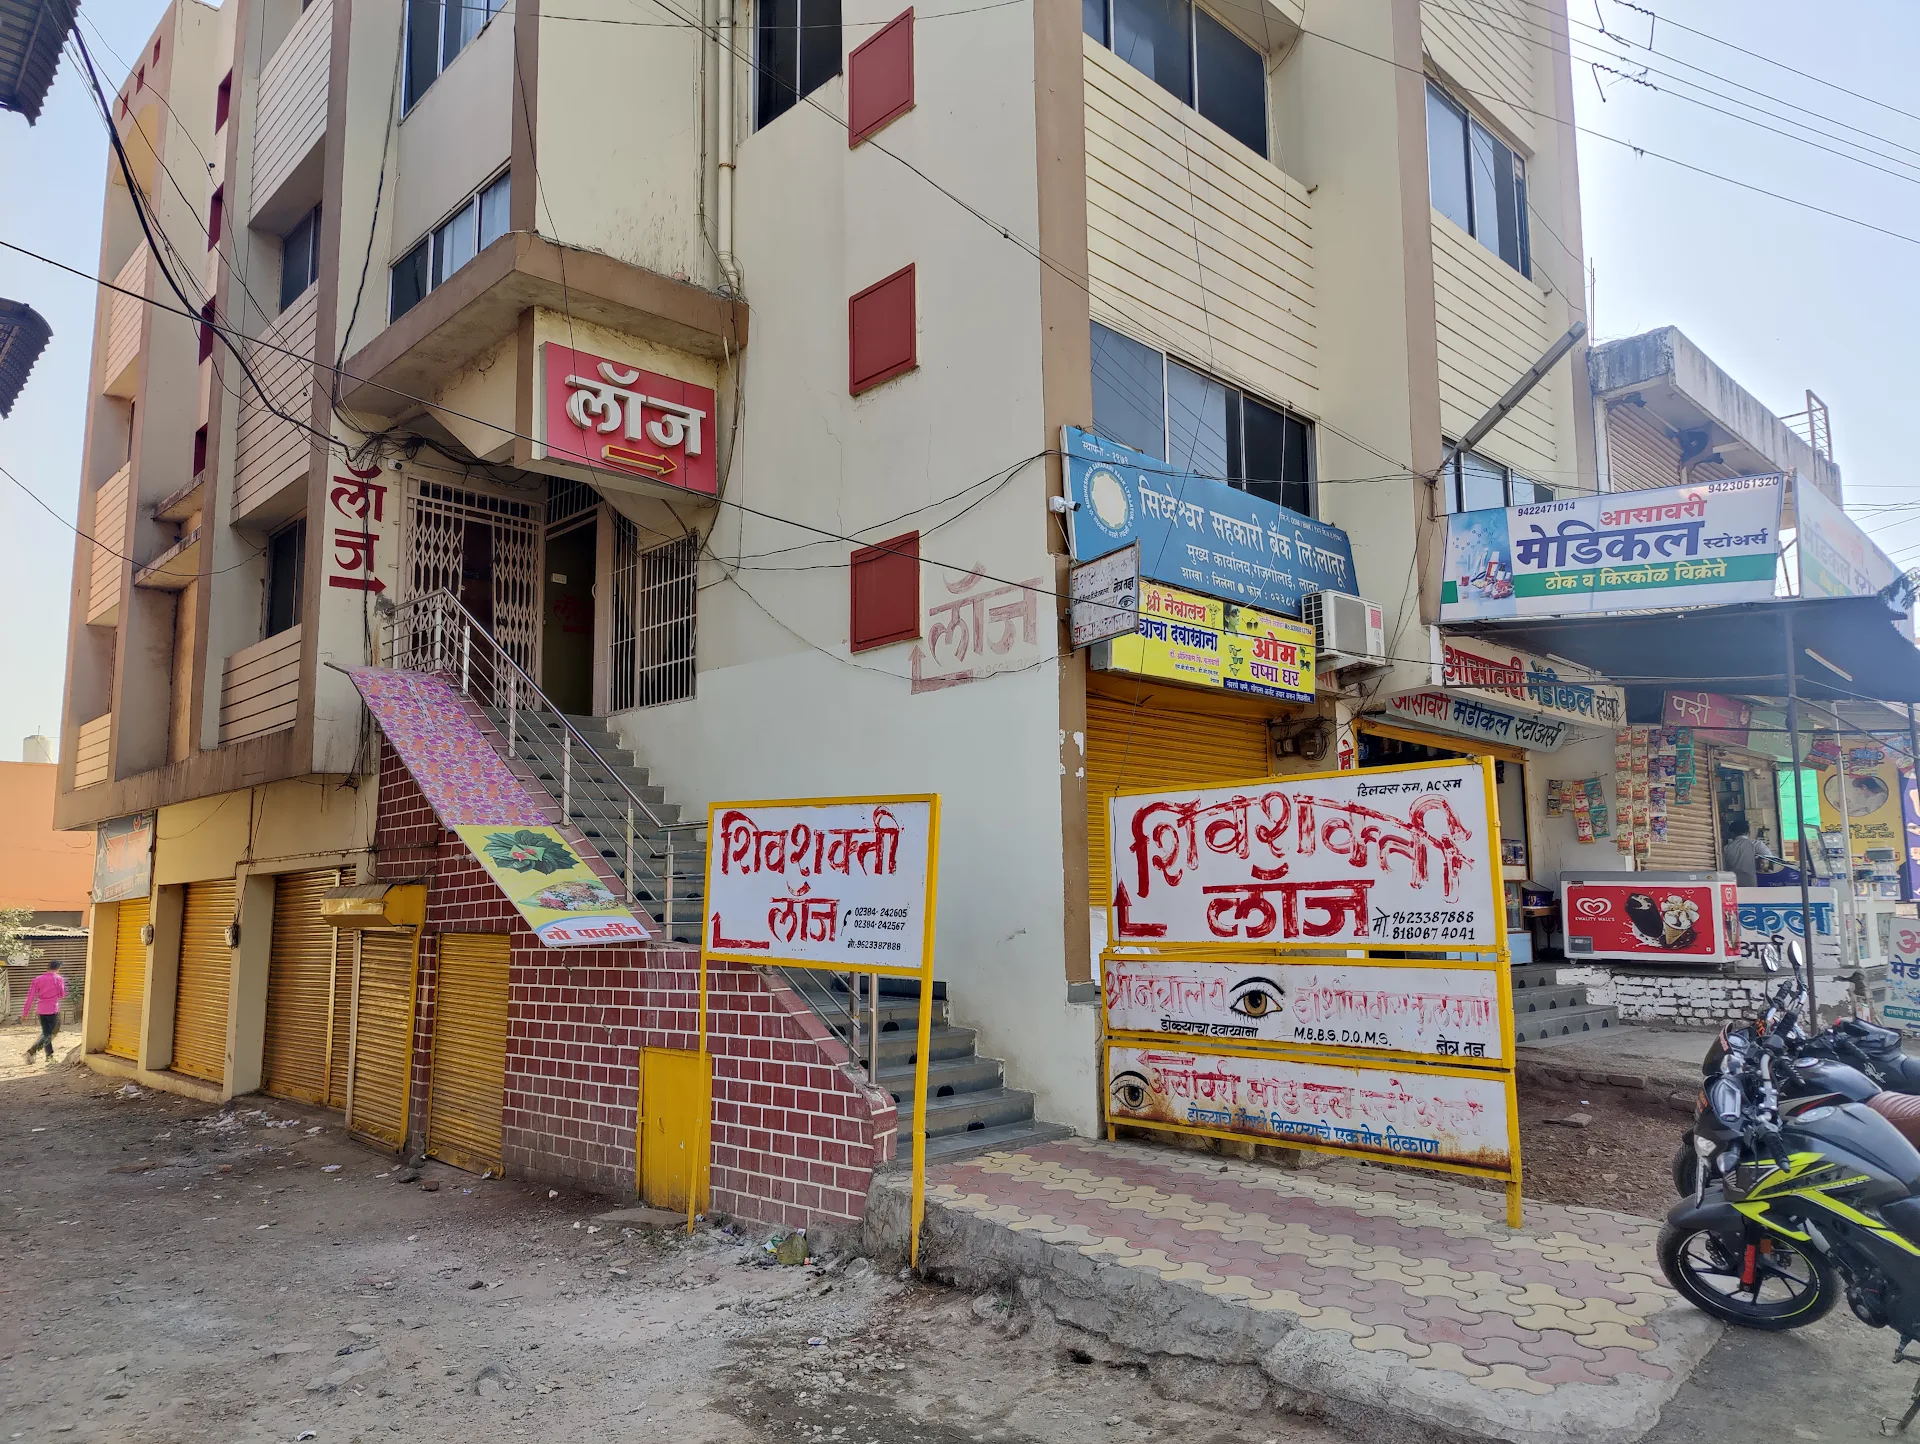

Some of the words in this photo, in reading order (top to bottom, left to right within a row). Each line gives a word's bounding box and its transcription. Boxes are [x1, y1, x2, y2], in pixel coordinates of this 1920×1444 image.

[565, 362, 706, 456] लॉज
[1708, 476, 1779, 494] 9423061320
[330, 460, 387, 572] लॉज
[1517, 501, 1576, 517] 9422471014
[1600, 493, 1707, 526] आसावरी
[1209, 509, 1265, 553] सहकारी
[1516, 520, 1705, 569] मेडिकल
[1703, 528, 1768, 549] स्टोअर्स
[1186, 543, 1209, 565] मुख्य
[1181, 567, 1203, 583] शाखा
[1246, 581, 1262, 598] फोन
[1545, 572, 1577, 590] ठोक
[1582, 573, 1595, 587] व
[1600, 565, 1669, 588] किरकोळ
[1674, 558, 1728, 582] विक्रेते
[928, 560, 1043, 667] लॉज
[1146, 589, 1161, 613] श्री
[1164, 592, 1207, 622] नेत्रालय
[1170, 623, 1219, 652] दवाखाना
[1252, 631, 1297, 666] ओम
[1282, 668, 1300, 687] घर
[1445, 645, 1527, 703] आसावरी
[1672, 693, 1711, 725] परी
[1426, 781, 1441, 792] AC
[768, 881, 840, 943] लॉज
[1202, 862, 1375, 939] लॉज
[543, 926, 573, 941] नो
[1392, 911, 1474, 924] 9623387888
[1160, 1015, 1209, 1035] डोळ्याचा
[1210, 1023, 1259, 1039] दवाखाना
[1293, 1026, 1338, 1042] M.B.B.S.
[1341, 1029, 1392, 1046] D.O.M.S.
[1386, 1124, 1439, 1155] ठिकाण
